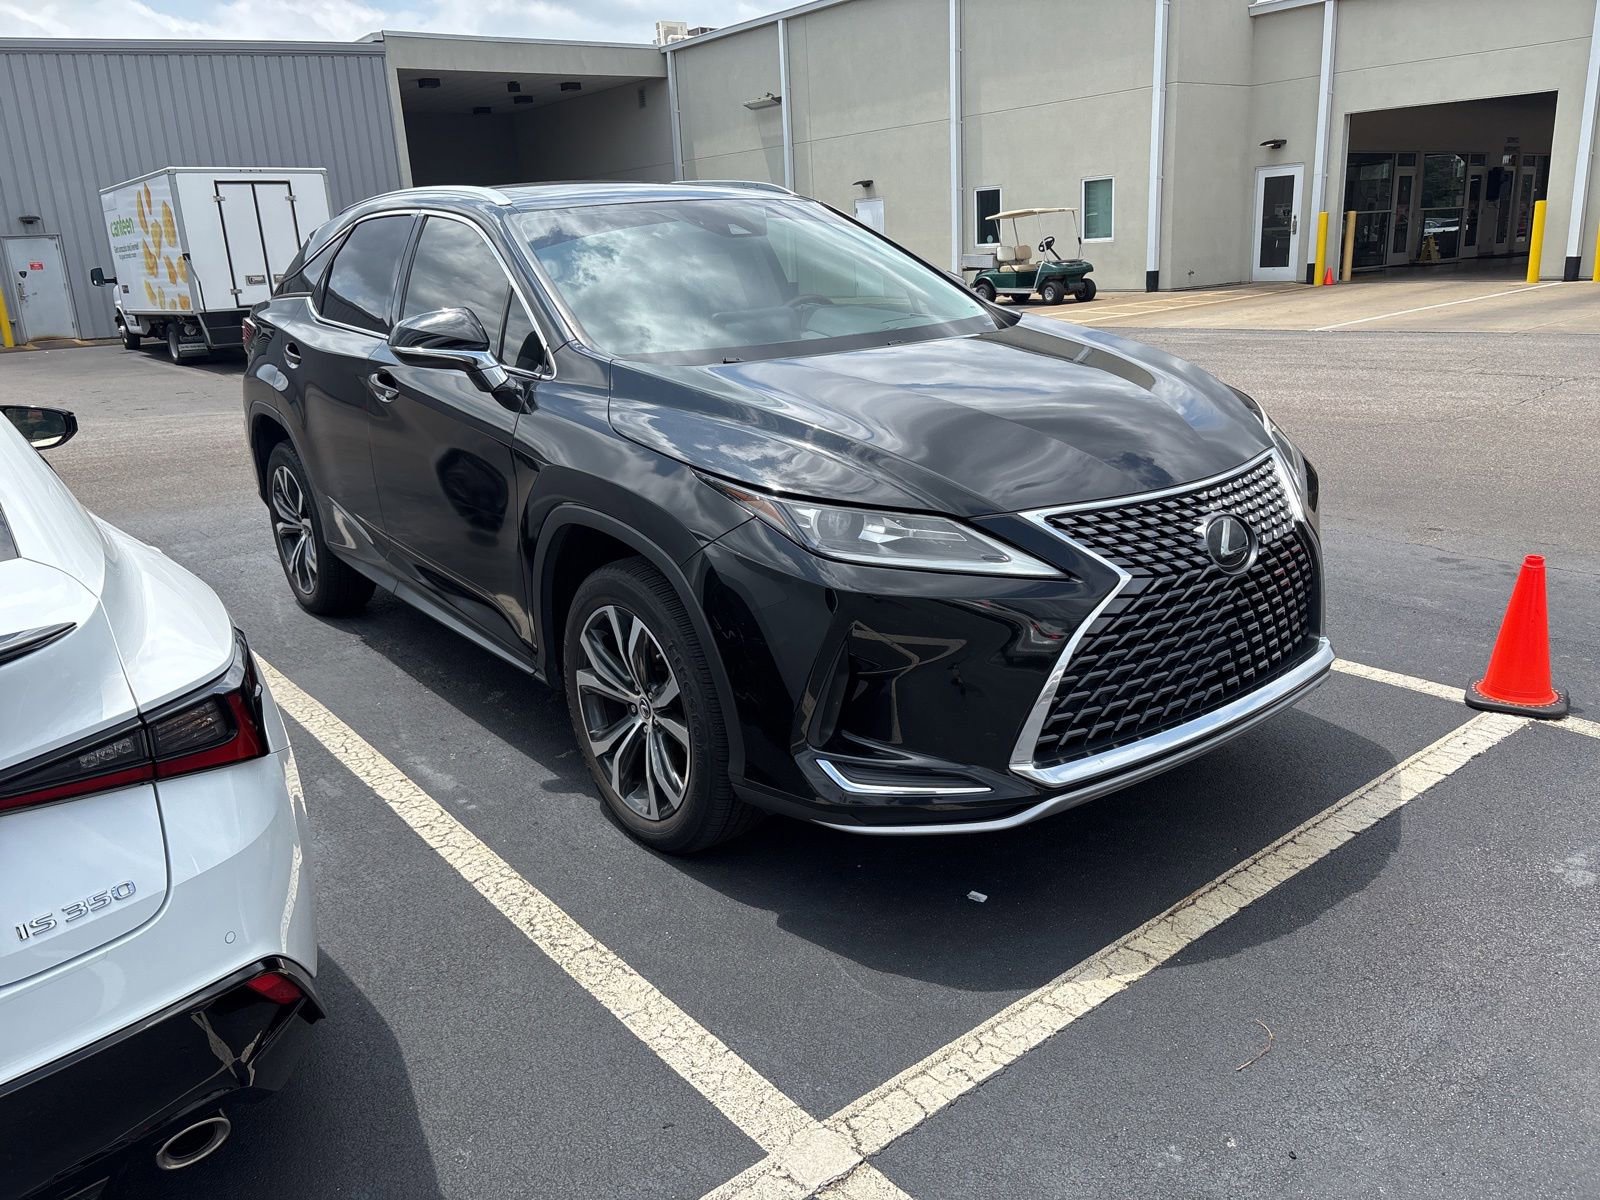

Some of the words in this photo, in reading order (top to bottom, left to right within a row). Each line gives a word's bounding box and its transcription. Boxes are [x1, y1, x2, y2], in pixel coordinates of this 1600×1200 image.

[110, 215, 135, 237] canteen
[15, 912, 58, 942] IS
[61, 880, 137, 923] 350
